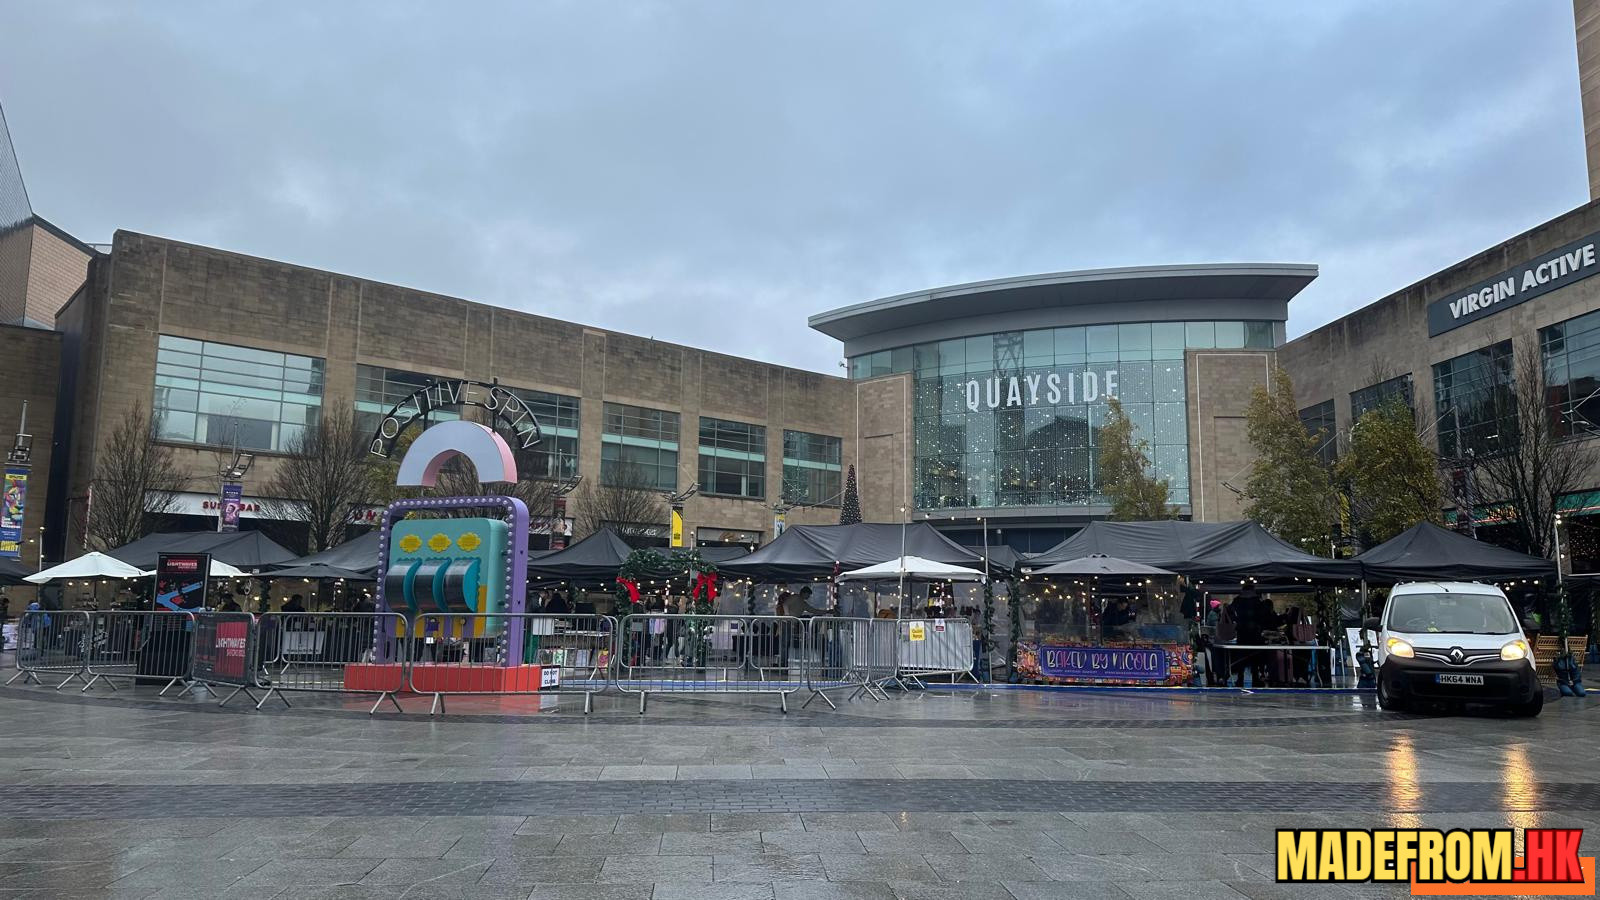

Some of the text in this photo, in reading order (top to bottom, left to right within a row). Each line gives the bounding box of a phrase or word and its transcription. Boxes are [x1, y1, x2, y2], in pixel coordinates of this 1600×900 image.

[1449, 243, 1596, 319] VIRGIN ACTIVE
[966, 370, 1118, 413] QUAYSIDE
[370, 381, 541, 458] POSITIVE SPIN
[1046, 650, 1158, 671] BAKED BY NICOLA
[1440, 675, 1463, 683] HK64
[1465, 676, 1482, 684] WNA
